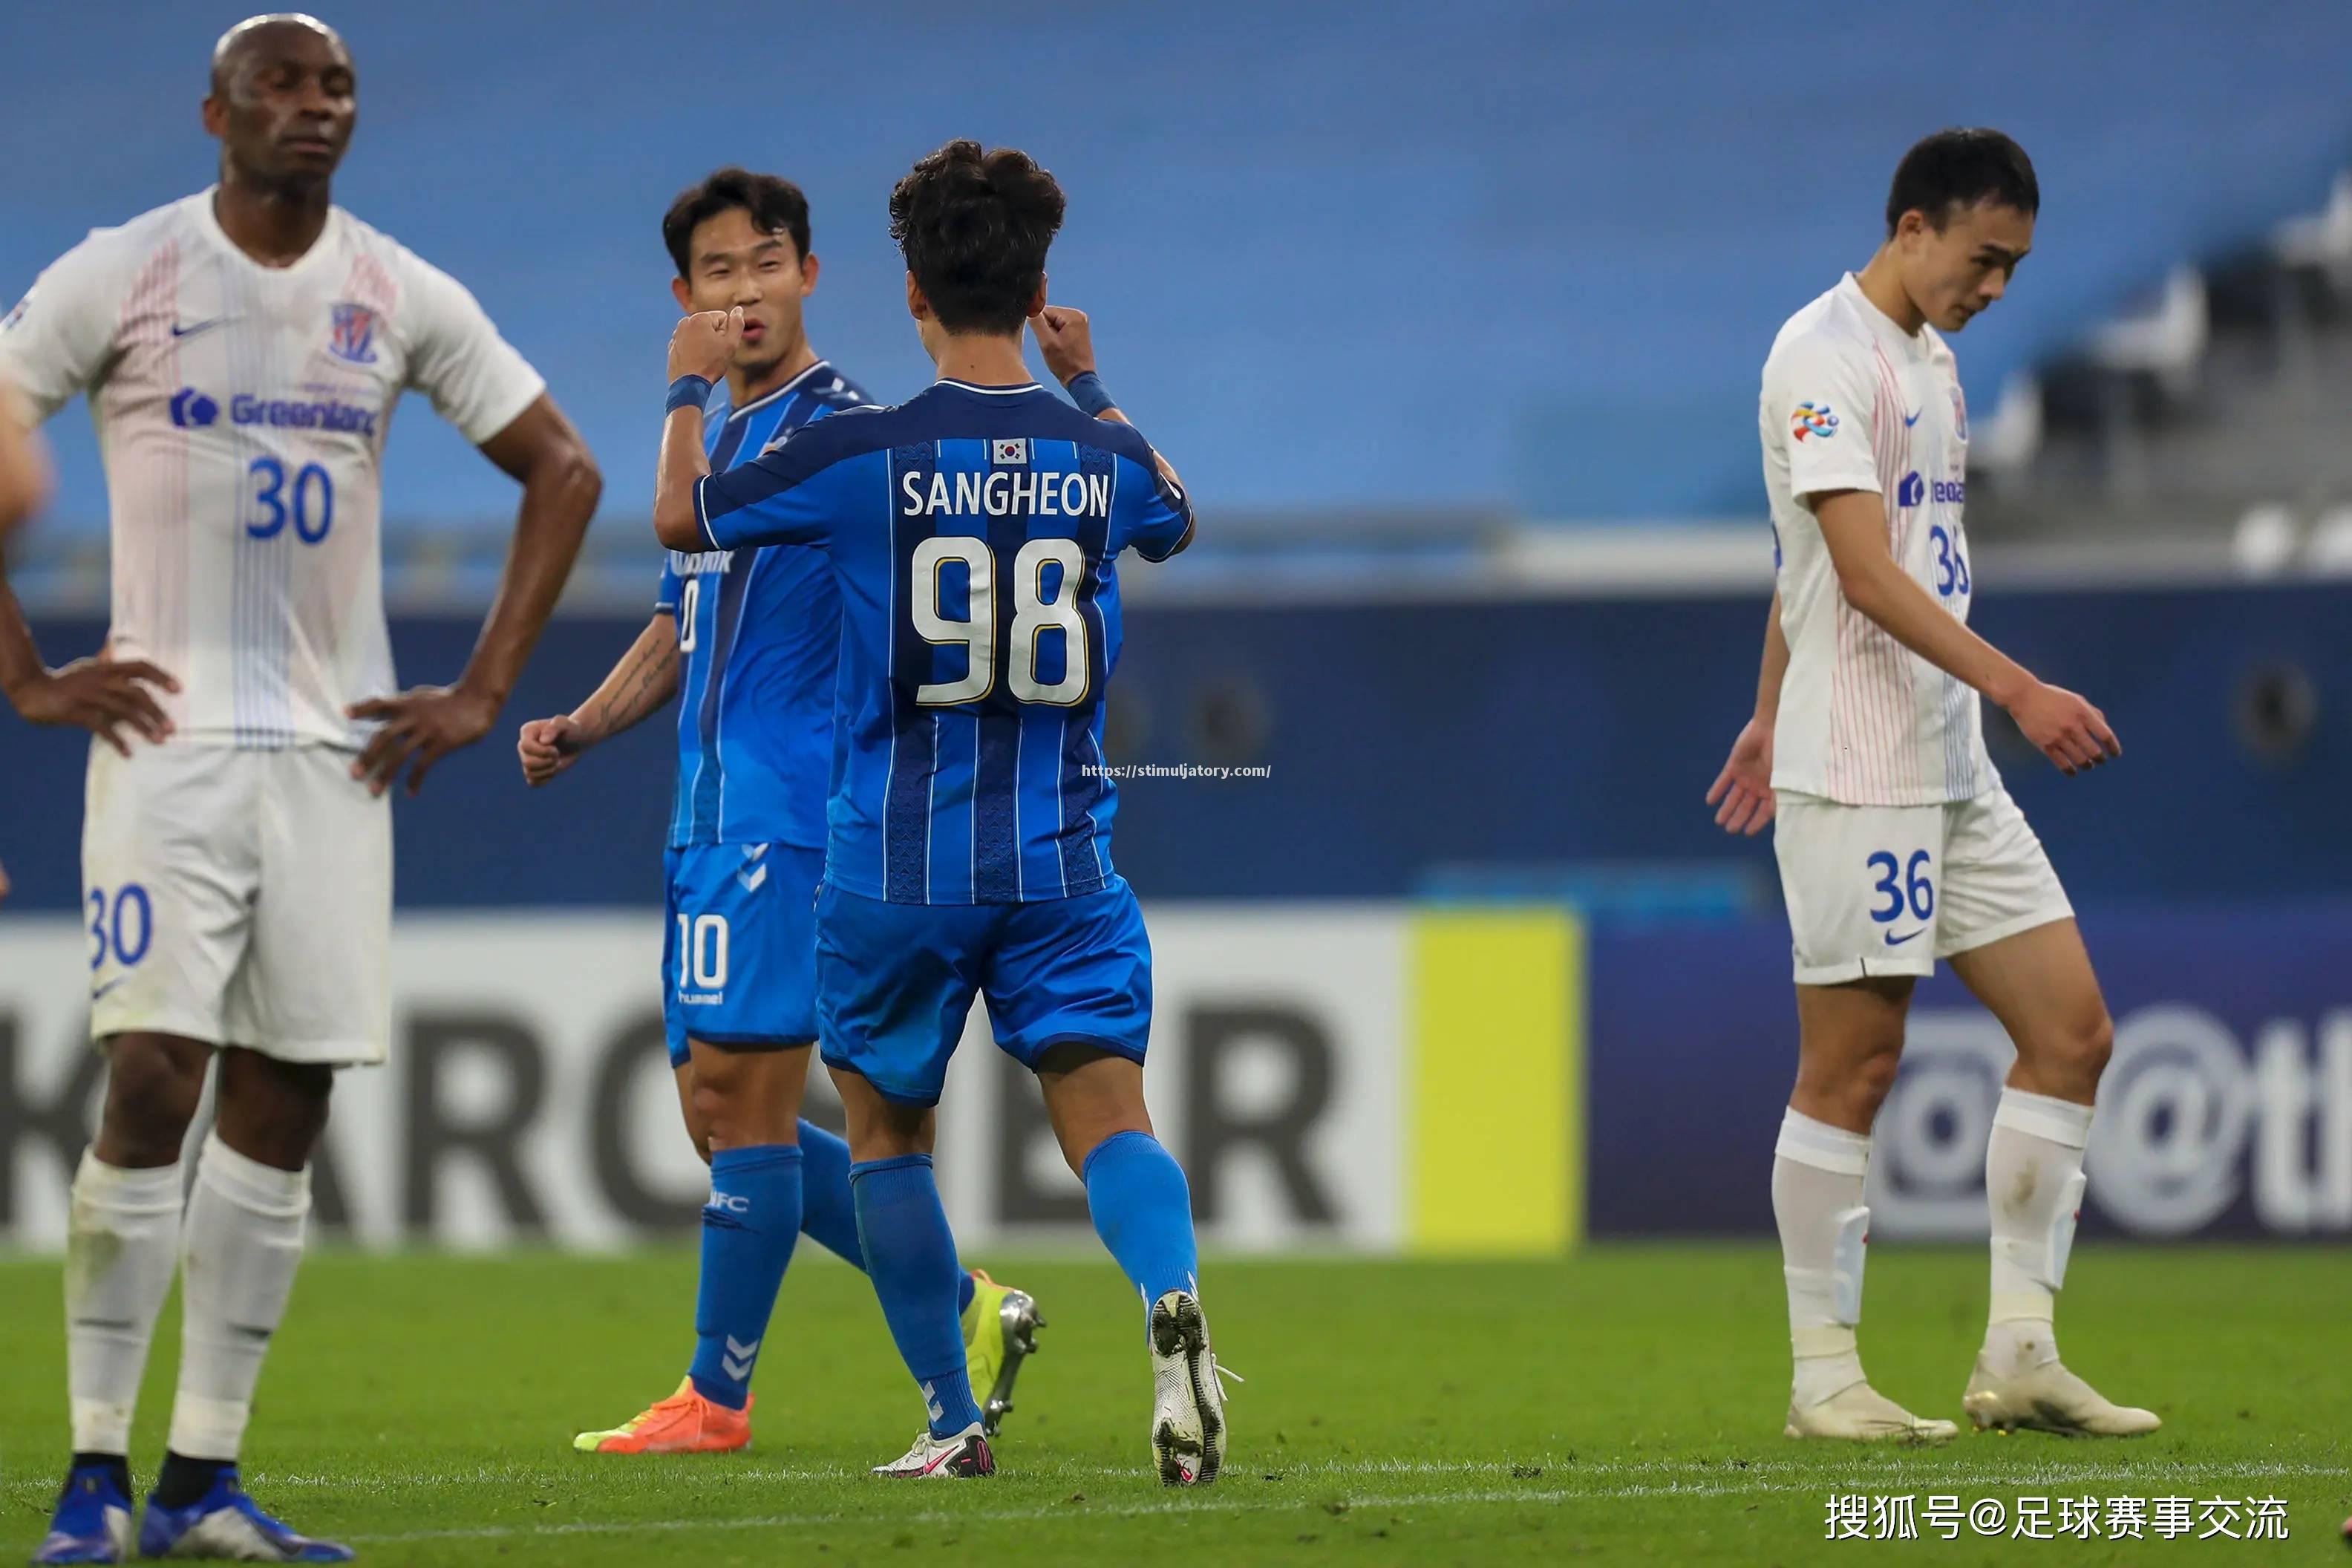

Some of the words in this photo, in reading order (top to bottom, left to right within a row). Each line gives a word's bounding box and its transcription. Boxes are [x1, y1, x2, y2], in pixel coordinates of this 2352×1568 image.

[246, 457, 335, 546] 30
[902, 470, 1108, 517] SANGHEON
[1930, 524, 1970, 596] 36
[911, 535, 1091, 708] 98
[1866, 848, 1934, 924] 36
[88, 883, 152, 971] 30
[677, 912, 729, 989] 10
